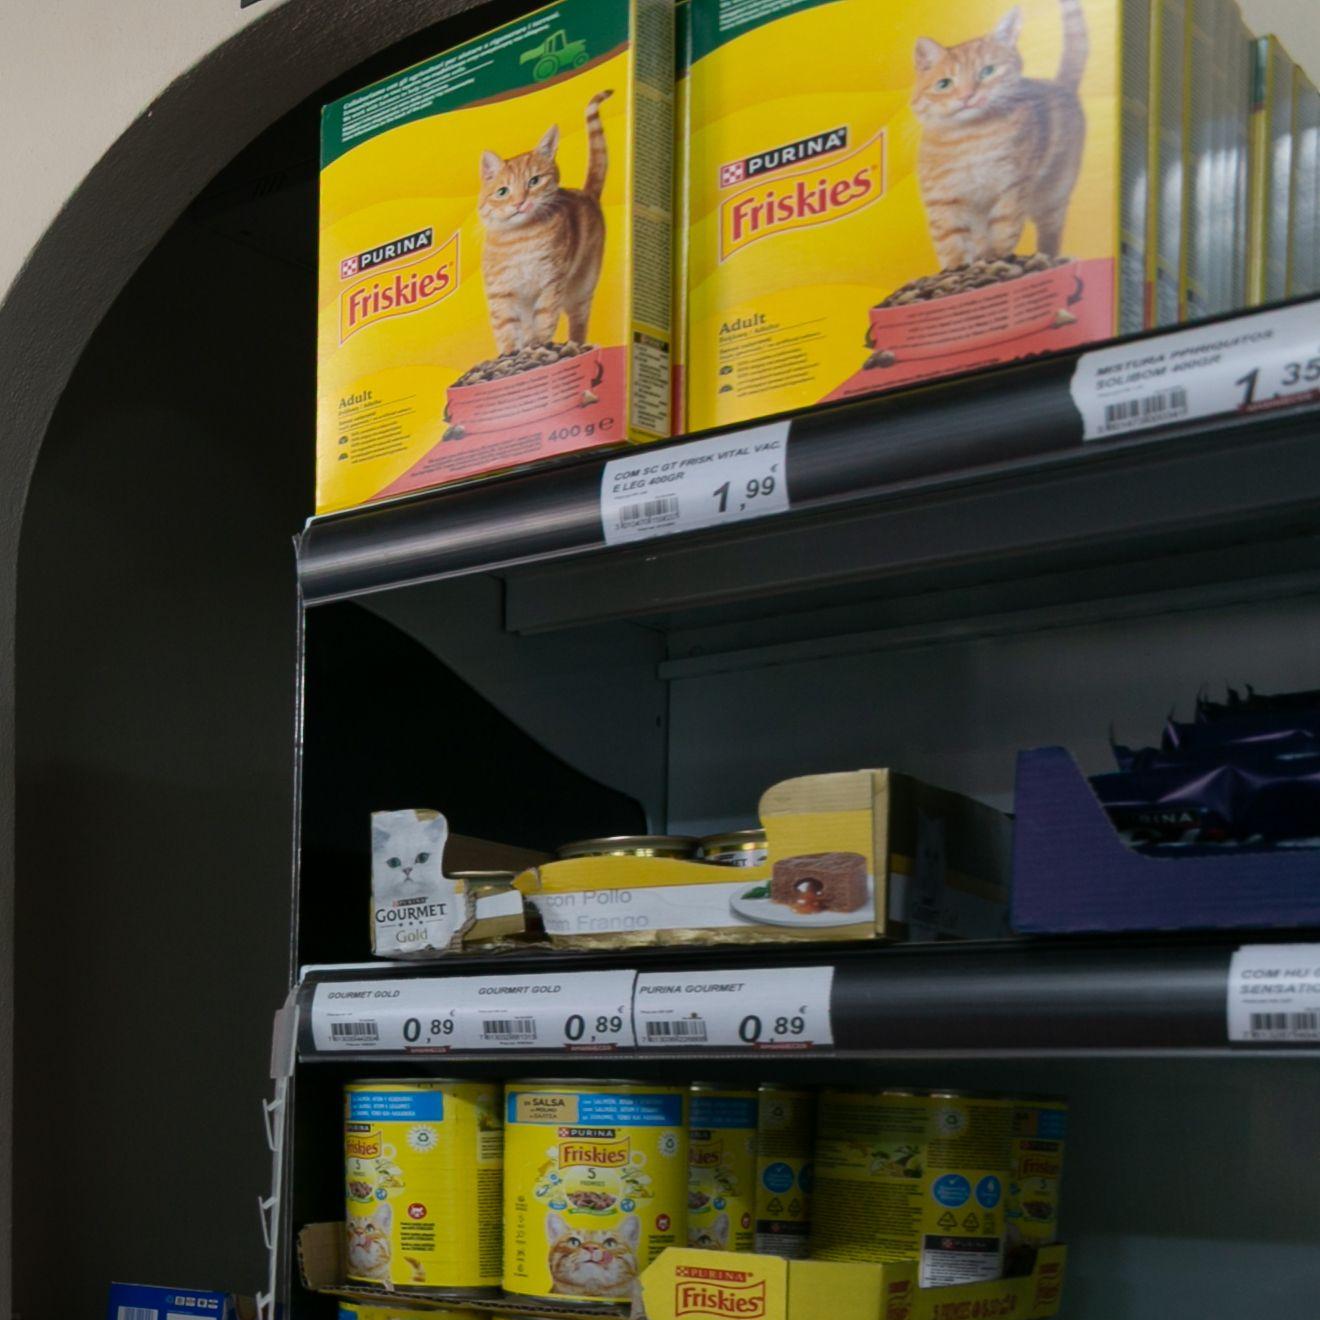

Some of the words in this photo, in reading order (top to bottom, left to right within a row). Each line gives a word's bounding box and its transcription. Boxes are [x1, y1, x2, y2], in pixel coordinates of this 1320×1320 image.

[749, 132, 844, 173] PURINA
[731, 168, 872, 241] Friskies
[361, 233, 429, 268] PURINA
[349, 265, 450, 325] Friskies
[719, 313, 766, 334] Adult
[339, 391, 372, 409] Adult
[614, 469, 639, 480] COM
[643, 465, 659, 475] SC
[662, 462, 677, 472] GT
[680, 454, 713, 468] FRISK
[718, 448, 749, 459] VITAL
[713, 476, 776, 512] 1,99
[582, 887, 632, 907] Pollo
[374, 902, 447, 925] GOURMET
[577, 913, 649, 932] Frango
[395, 928, 429, 944] Gold
[328, 990, 371, 1000] GOURMET
[373, 989, 400, 999] GOLD
[532, 984, 561, 994] GOLD
[639, 984, 682, 995] PURINA
[685, 982, 745, 994] GOURMET
[402, 1017, 454, 1046] 0,89
[564, 1014, 623, 1043] 0,89
[532, 1097, 566, 1108] SALSA
[563, 1145, 625, 1163] Friskies
[681, 1286, 760, 1313] Friskies
